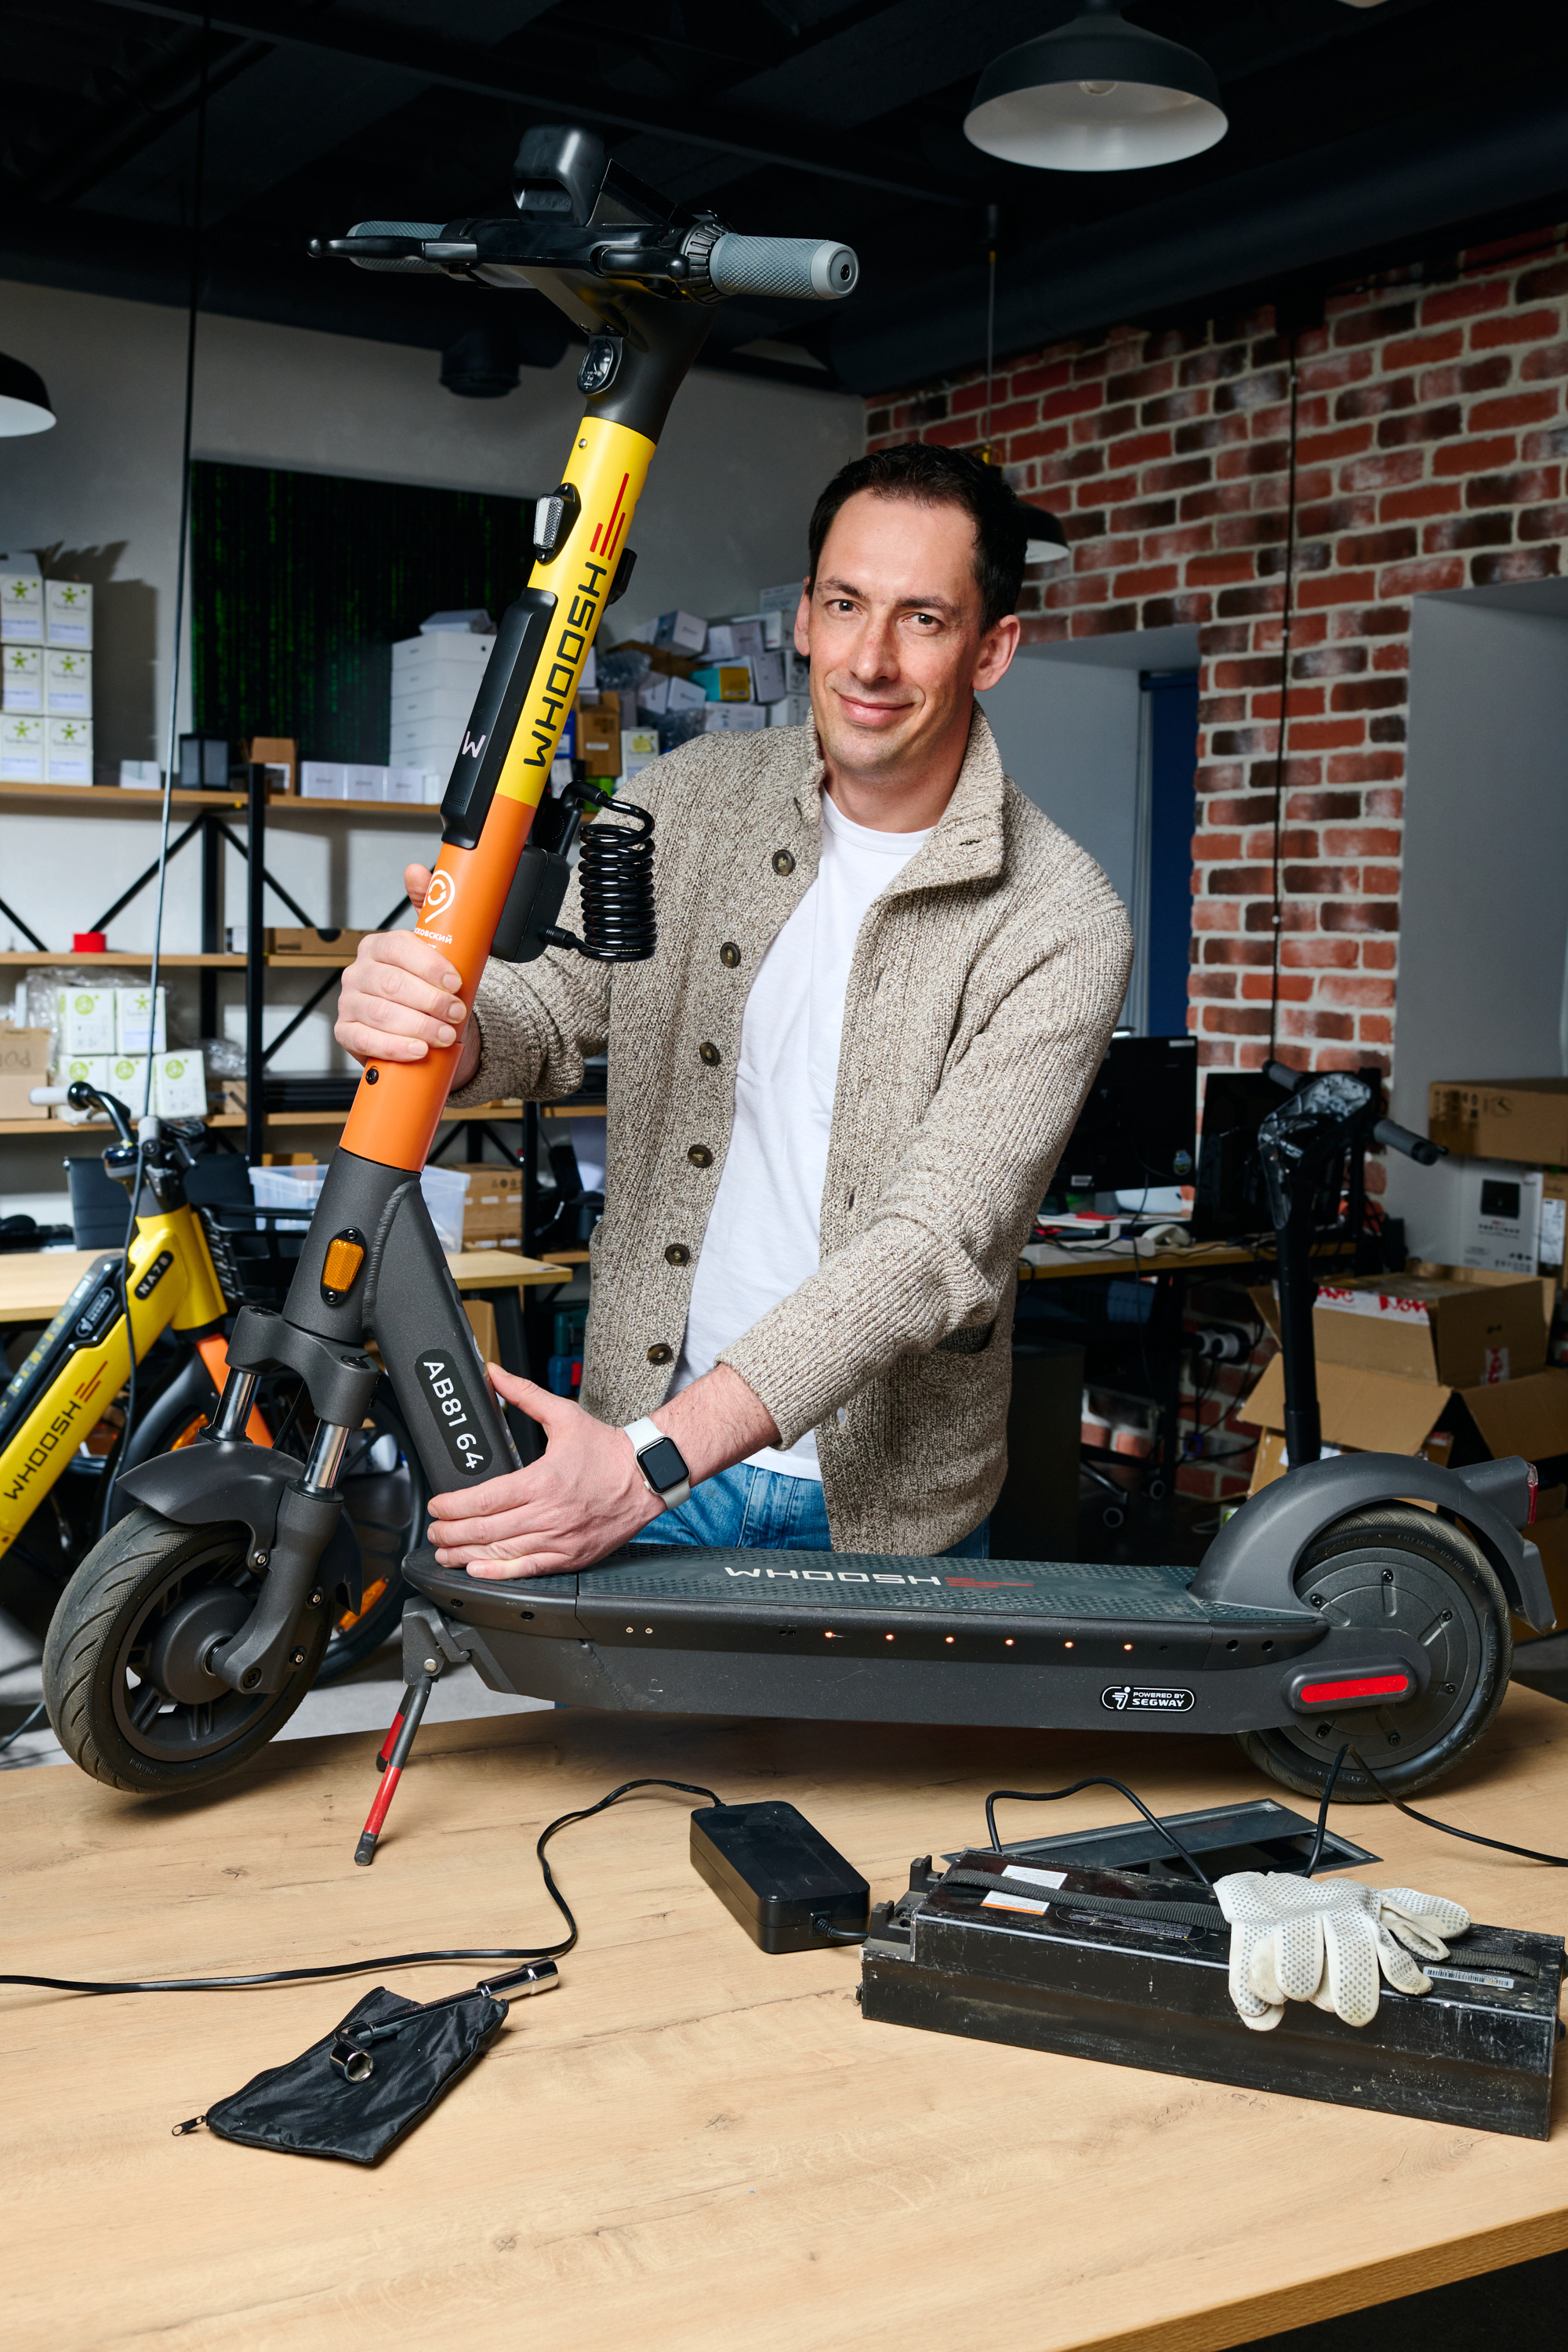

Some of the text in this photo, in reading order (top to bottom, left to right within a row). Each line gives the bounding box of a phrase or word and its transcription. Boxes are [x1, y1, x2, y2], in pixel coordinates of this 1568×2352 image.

[523, 561, 608, 767] WHOOSH
[462, 731, 487, 758] W
[423, 1361, 485, 1469] AB81 64
[4, 1400, 82, 1500] WHOOSH
[724, 1567, 942, 1585] WHOOSH
[1132, 1698, 1185, 1707] SEGWAY
